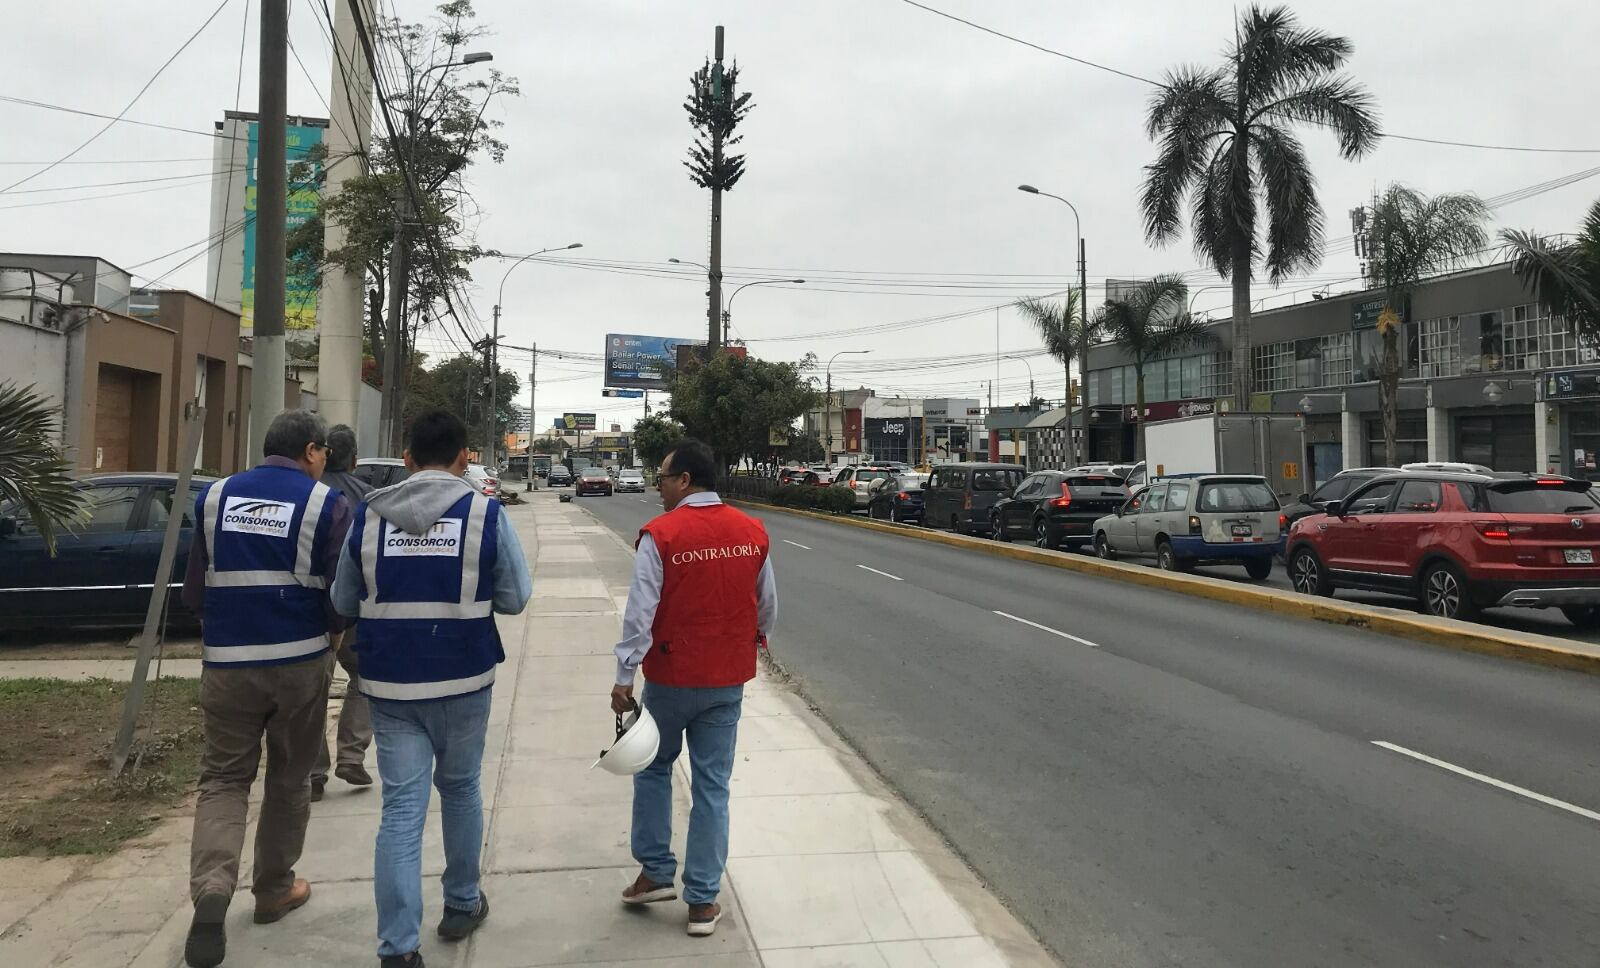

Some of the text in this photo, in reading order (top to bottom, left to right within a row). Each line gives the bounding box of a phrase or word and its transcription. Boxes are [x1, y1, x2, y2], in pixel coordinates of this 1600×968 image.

[612, 350, 635, 359] Bailar
[612, 361, 635, 371] Señal
[882, 420, 905, 436] Jeep
[225, 514, 287, 529] CONSORCIO
[387, 538, 456, 547] CONSORCIO
[672, 542, 761, 565] CONTRALORÍA
